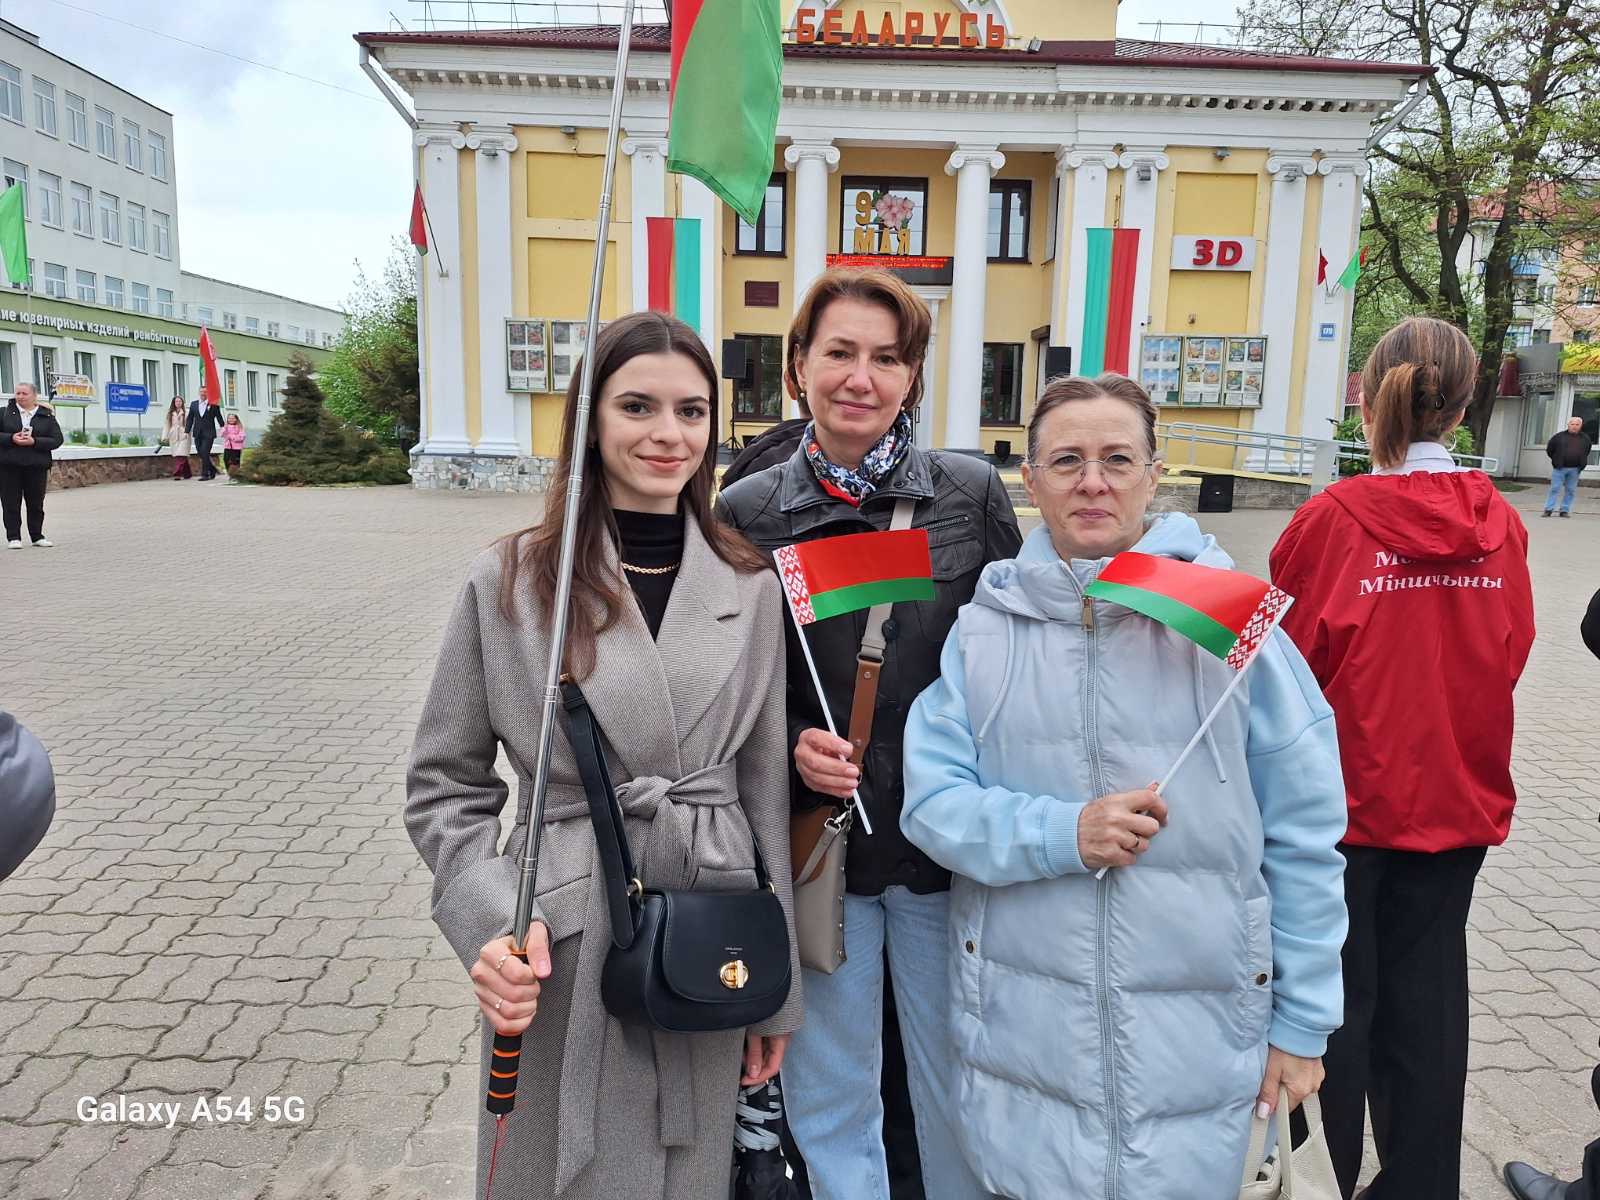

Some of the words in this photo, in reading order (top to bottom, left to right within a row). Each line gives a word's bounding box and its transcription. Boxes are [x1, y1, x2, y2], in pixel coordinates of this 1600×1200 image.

[796, 8, 1005, 49] БЕЛАРУСЬ
[855, 191, 872, 226] 9
[854, 226, 911, 254] МАЯ
[1192, 239, 1243, 267] 3D
[19, 310, 85, 332] ювелирных
[87, 321, 130, 338] изделий
[1357, 574, 1503, 596] Міншчыны
